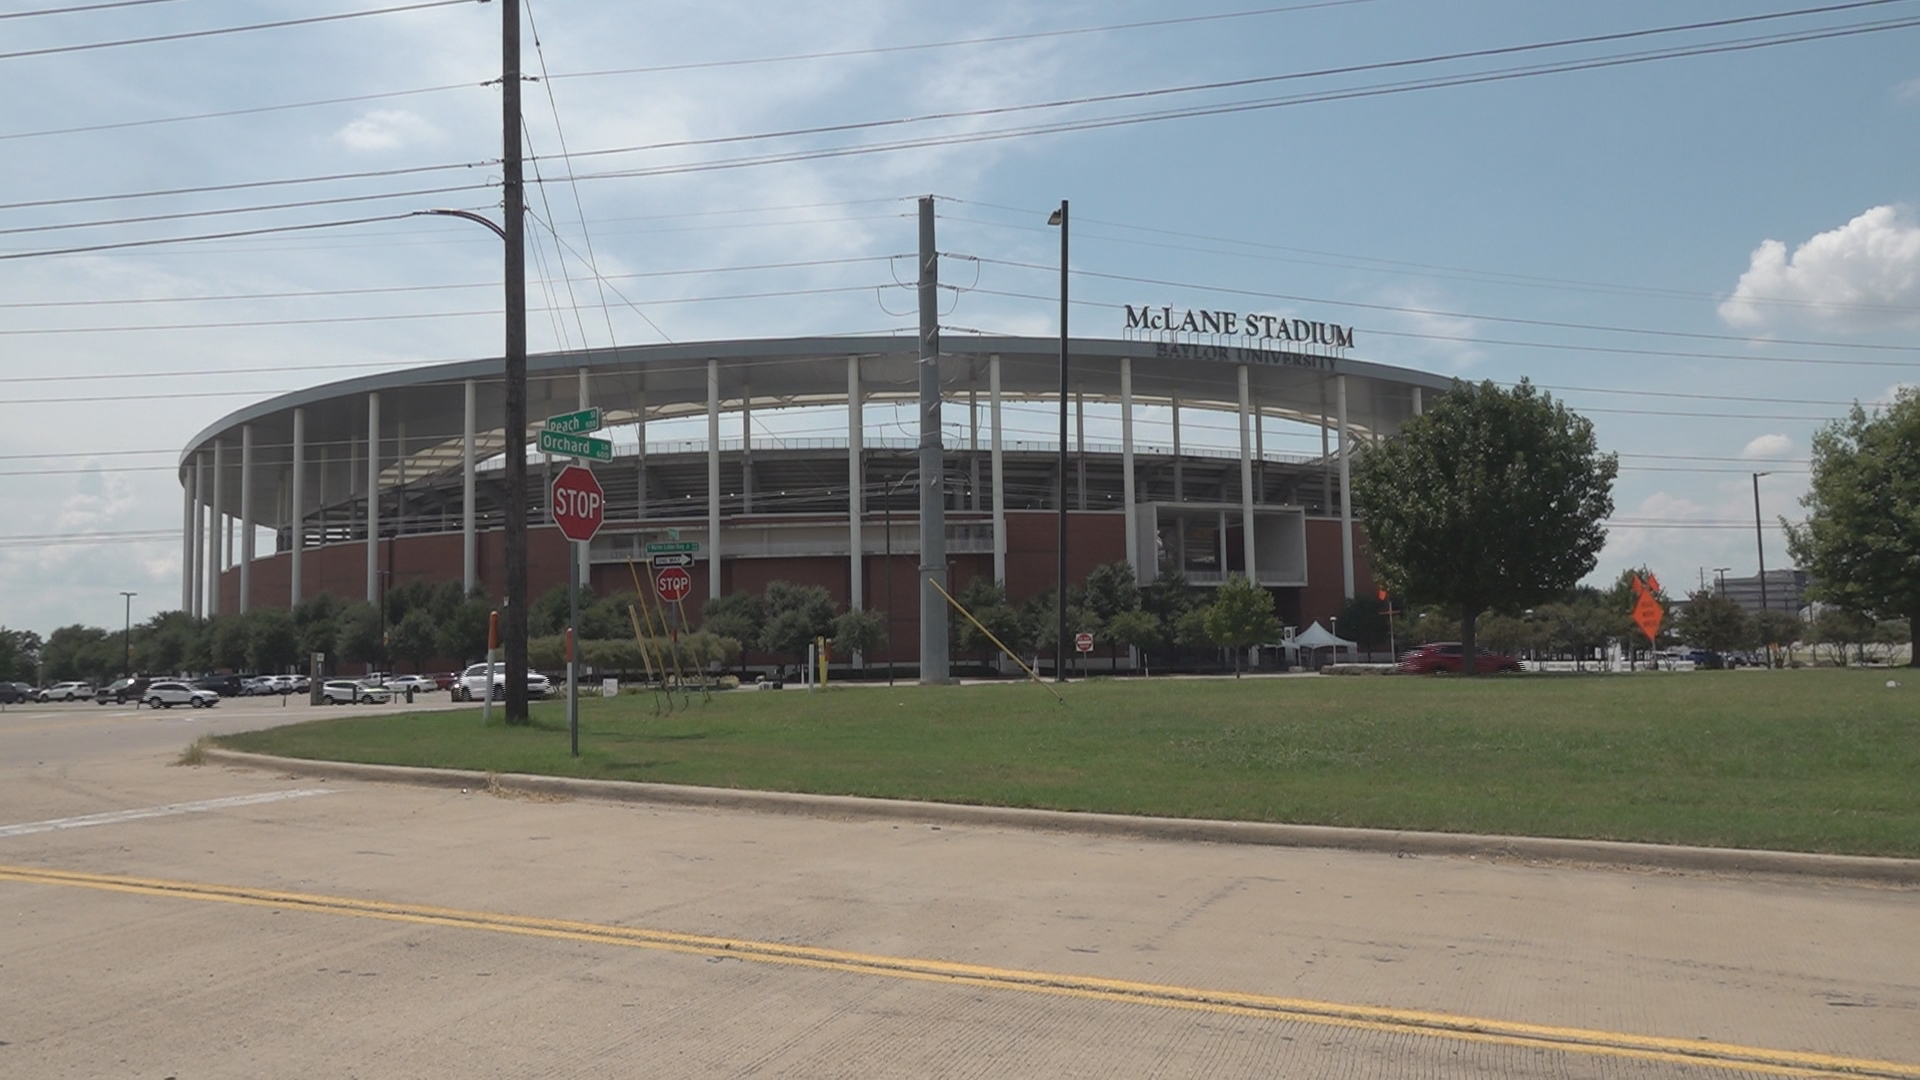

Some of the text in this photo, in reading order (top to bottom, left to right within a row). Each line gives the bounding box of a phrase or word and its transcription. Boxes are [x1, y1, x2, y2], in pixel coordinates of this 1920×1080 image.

[1125, 304, 1355, 348] McLANE STADIUM
[1157, 342, 1338, 370] BAYLOR UNIVERSITY
[550, 416, 580, 431] Peach
[543, 435, 590, 453] Orchard
[556, 487, 600, 519] STOP
[659, 577, 688, 591] STOP
